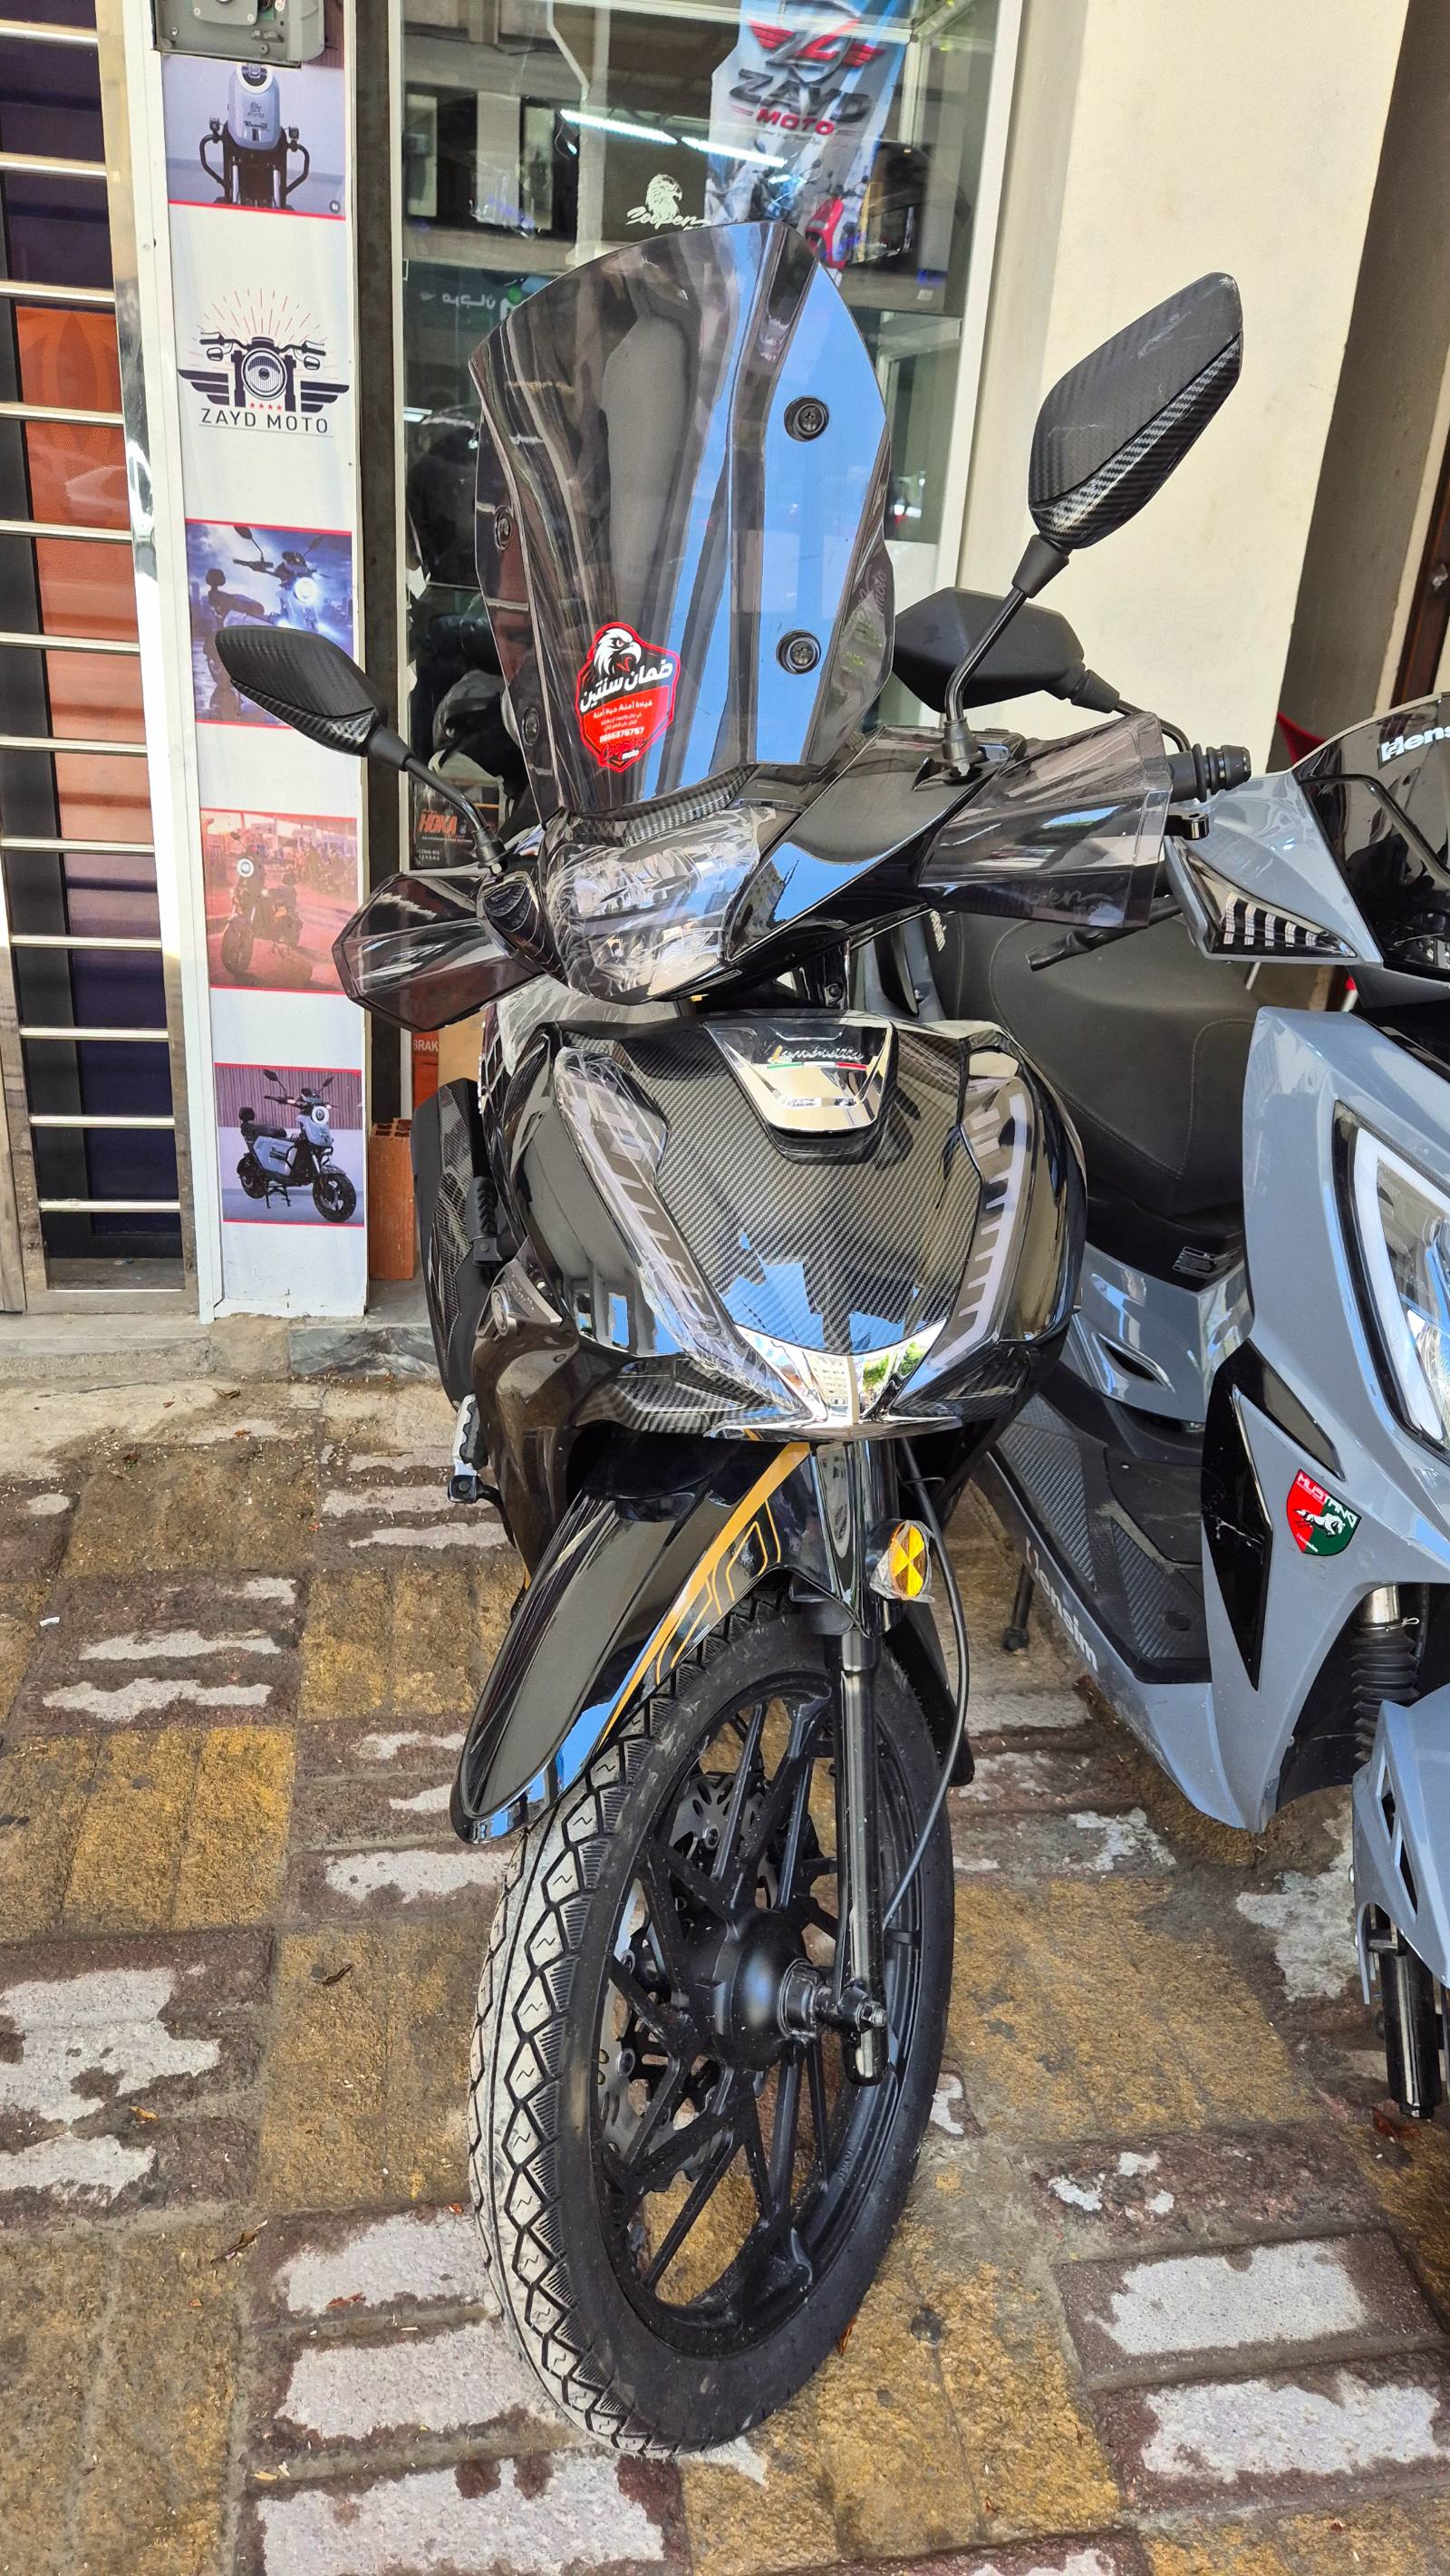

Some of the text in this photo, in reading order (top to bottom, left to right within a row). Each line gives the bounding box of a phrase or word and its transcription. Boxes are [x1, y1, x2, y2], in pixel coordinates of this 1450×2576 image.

[730, 68, 872, 122] ZAYD
[756, 107, 836, 135] MOTO
[201, 408, 328, 433] ZAYD MOTO
[580, 659, 673, 712] ضمان سنتين
[622, 749, 640, 760] moto
[1381, 726, 1450, 762] Hen
[1297, 1472, 1358, 1529] MUSTANG
[1025, 1536, 1098, 1672] Hensim
